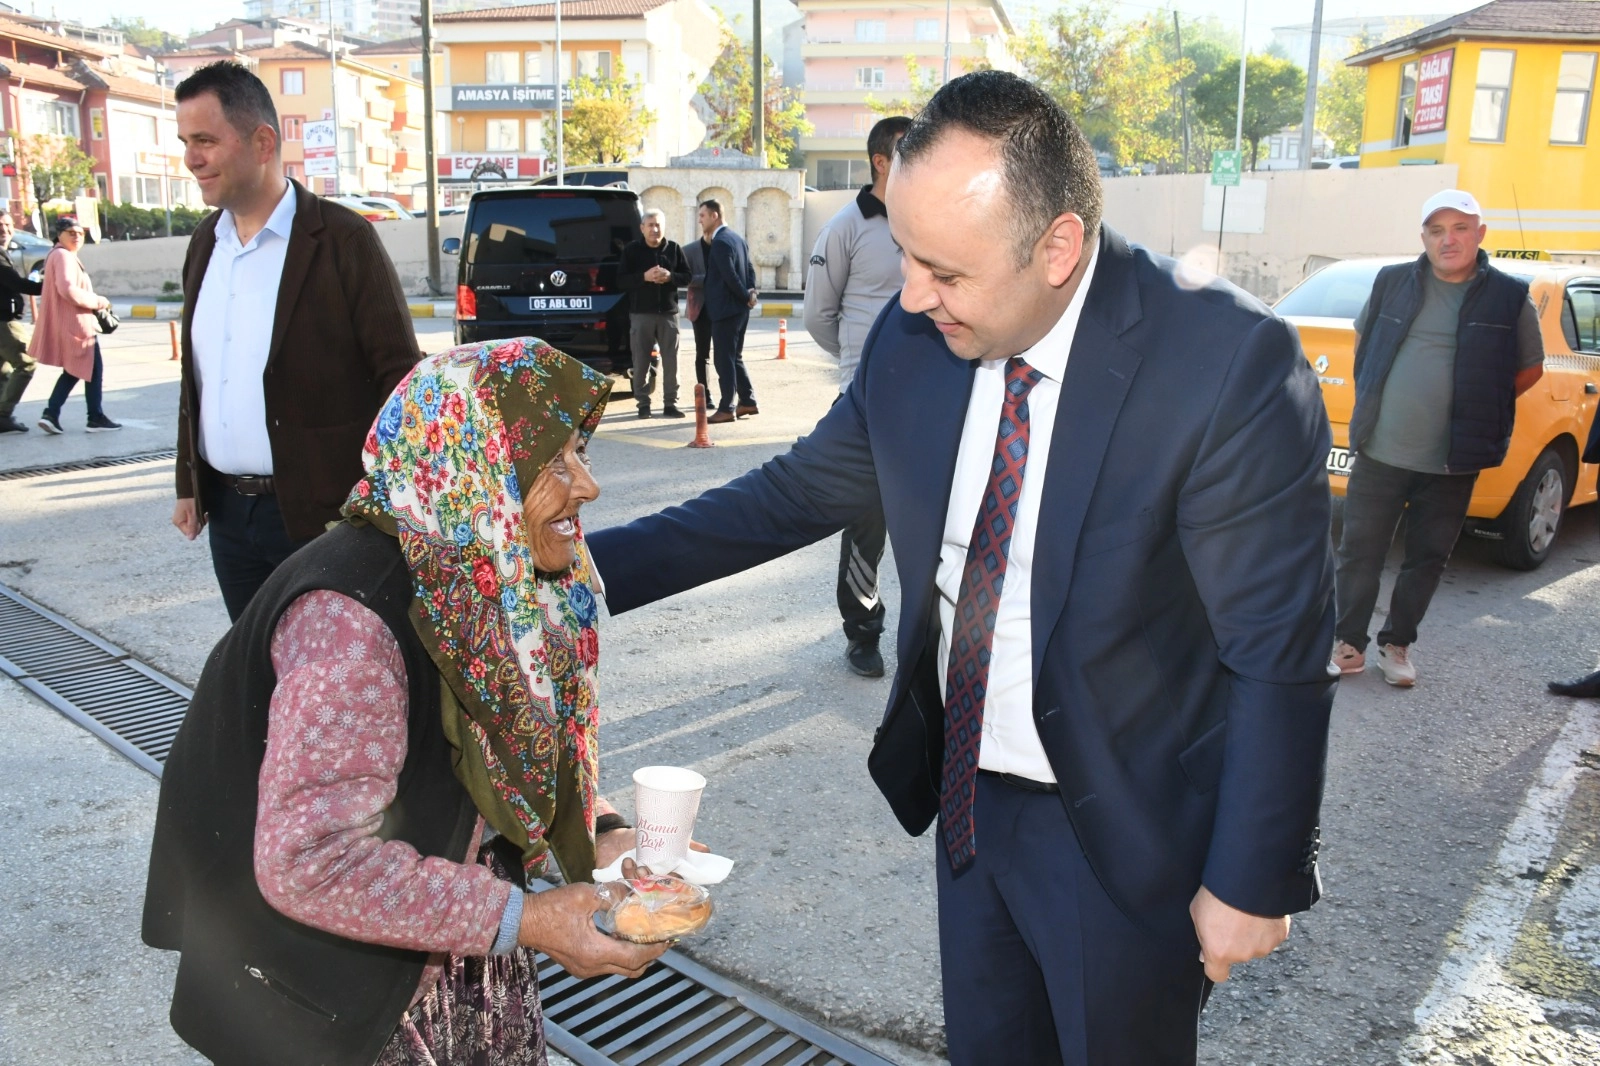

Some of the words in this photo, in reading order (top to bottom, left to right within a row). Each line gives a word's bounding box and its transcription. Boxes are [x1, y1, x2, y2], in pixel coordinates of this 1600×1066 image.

[1420, 54, 1450, 81] SAĞLIK
[457, 89, 509, 101] AMASYA
[512, 86, 555, 102] İŞİTME
[1421, 78, 1444, 106] TAKSİ
[533, 299, 547, 309] 05
[549, 299, 568, 309] ABL
[571, 298, 588, 308] 001
[1329, 451, 1350, 469] 10
[637, 829, 665, 852] Park
